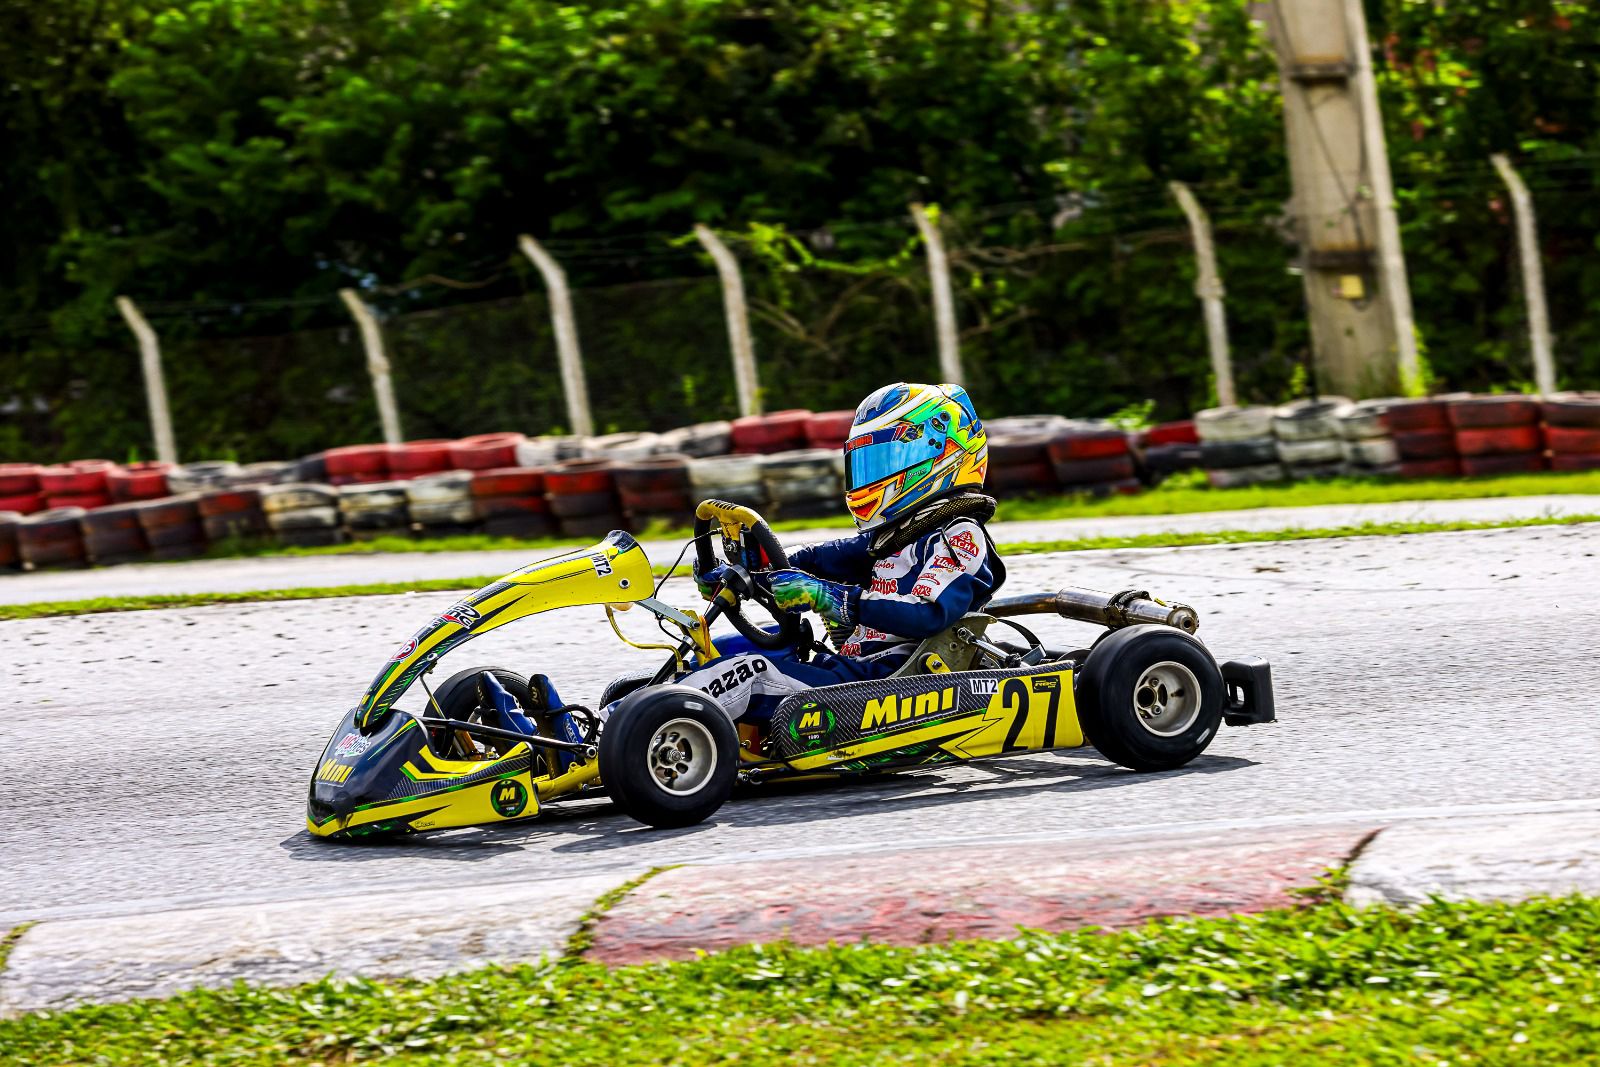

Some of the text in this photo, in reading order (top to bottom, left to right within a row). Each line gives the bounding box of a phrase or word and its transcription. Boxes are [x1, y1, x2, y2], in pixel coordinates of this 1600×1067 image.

[593, 554, 612, 576] MT2
[973, 679, 998, 694] MT2
[799, 711, 821, 728] M
[1002, 675, 1061, 753] 27
[499, 787, 516, 801] M
